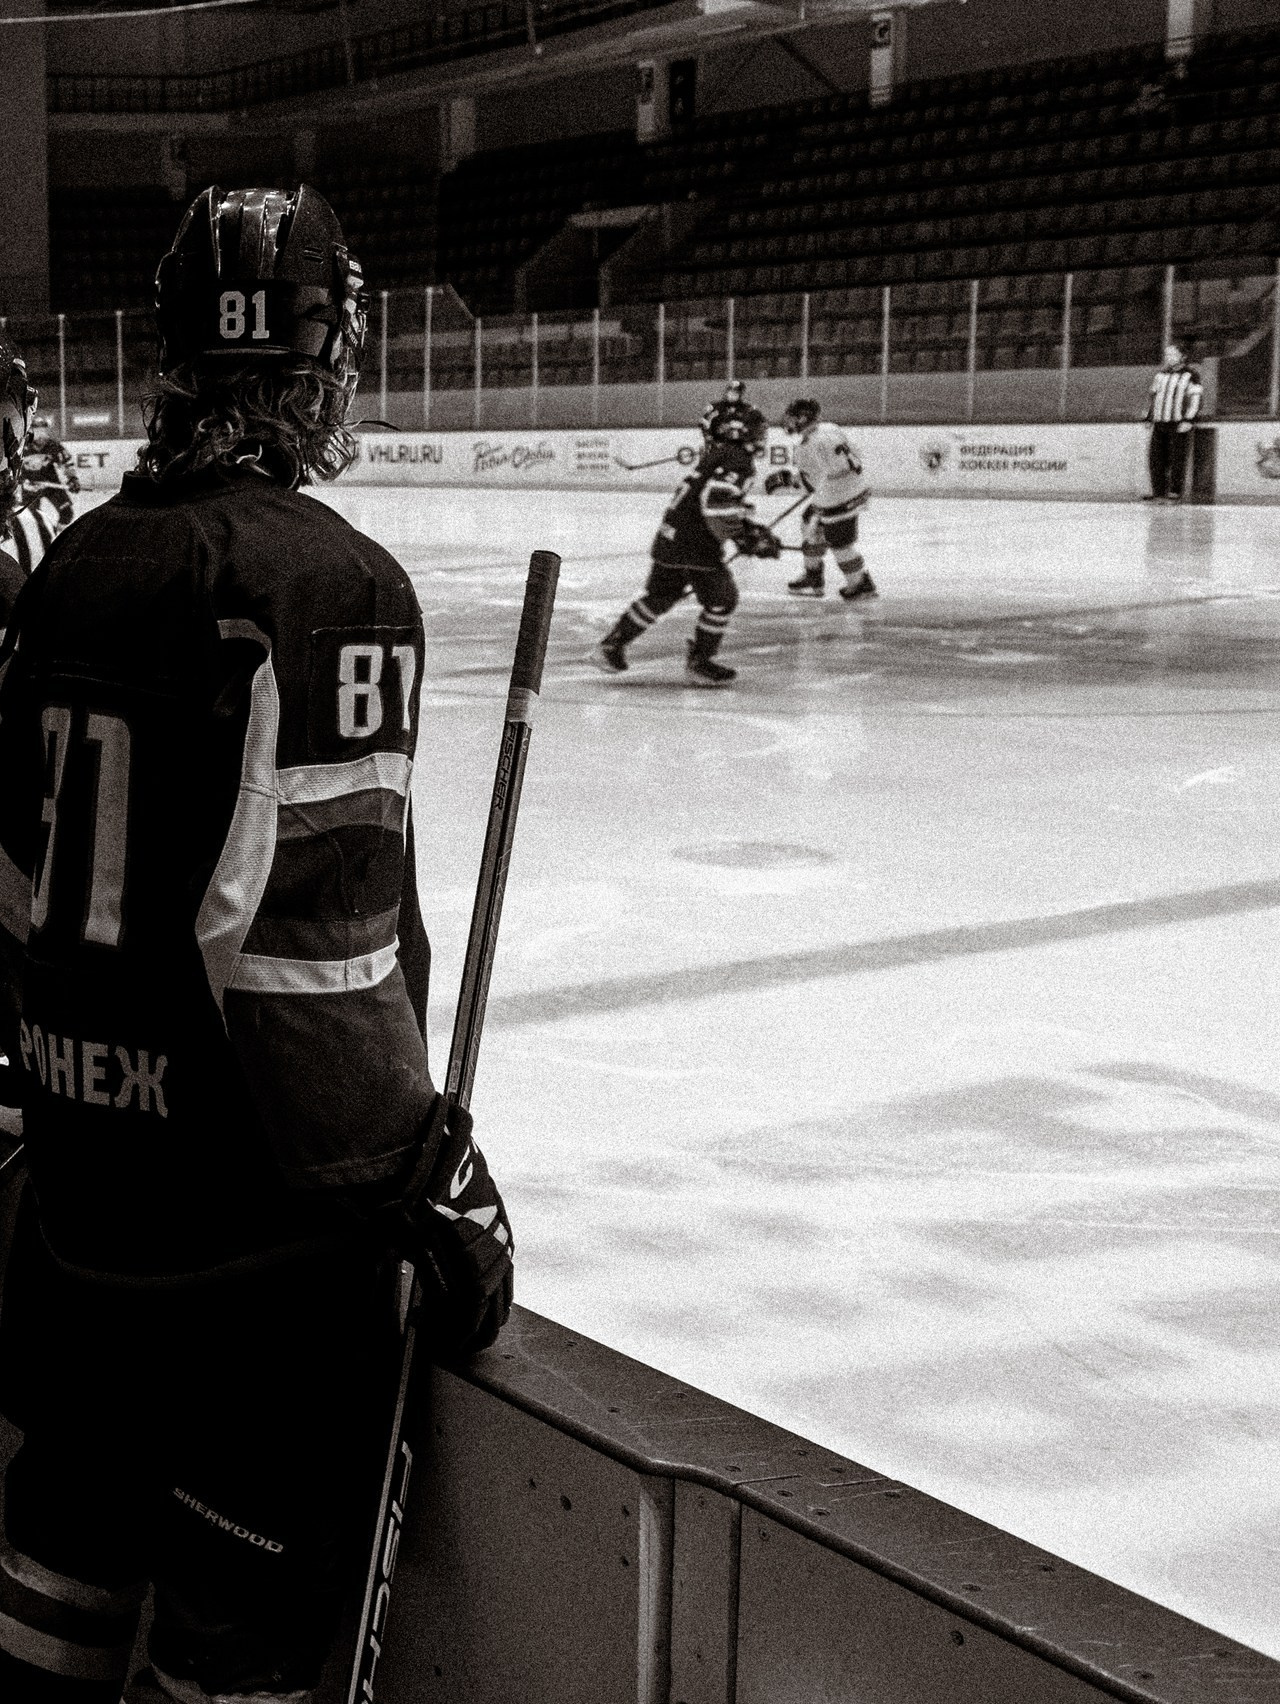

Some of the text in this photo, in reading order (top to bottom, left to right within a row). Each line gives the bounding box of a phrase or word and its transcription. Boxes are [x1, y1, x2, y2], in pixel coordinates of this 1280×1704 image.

[219, 289, 271, 340] 81
[336, 642, 418, 739] 81
[492, 722, 518, 812] FISCHER
[171, 1485, 286, 1555] SHERWOOD
